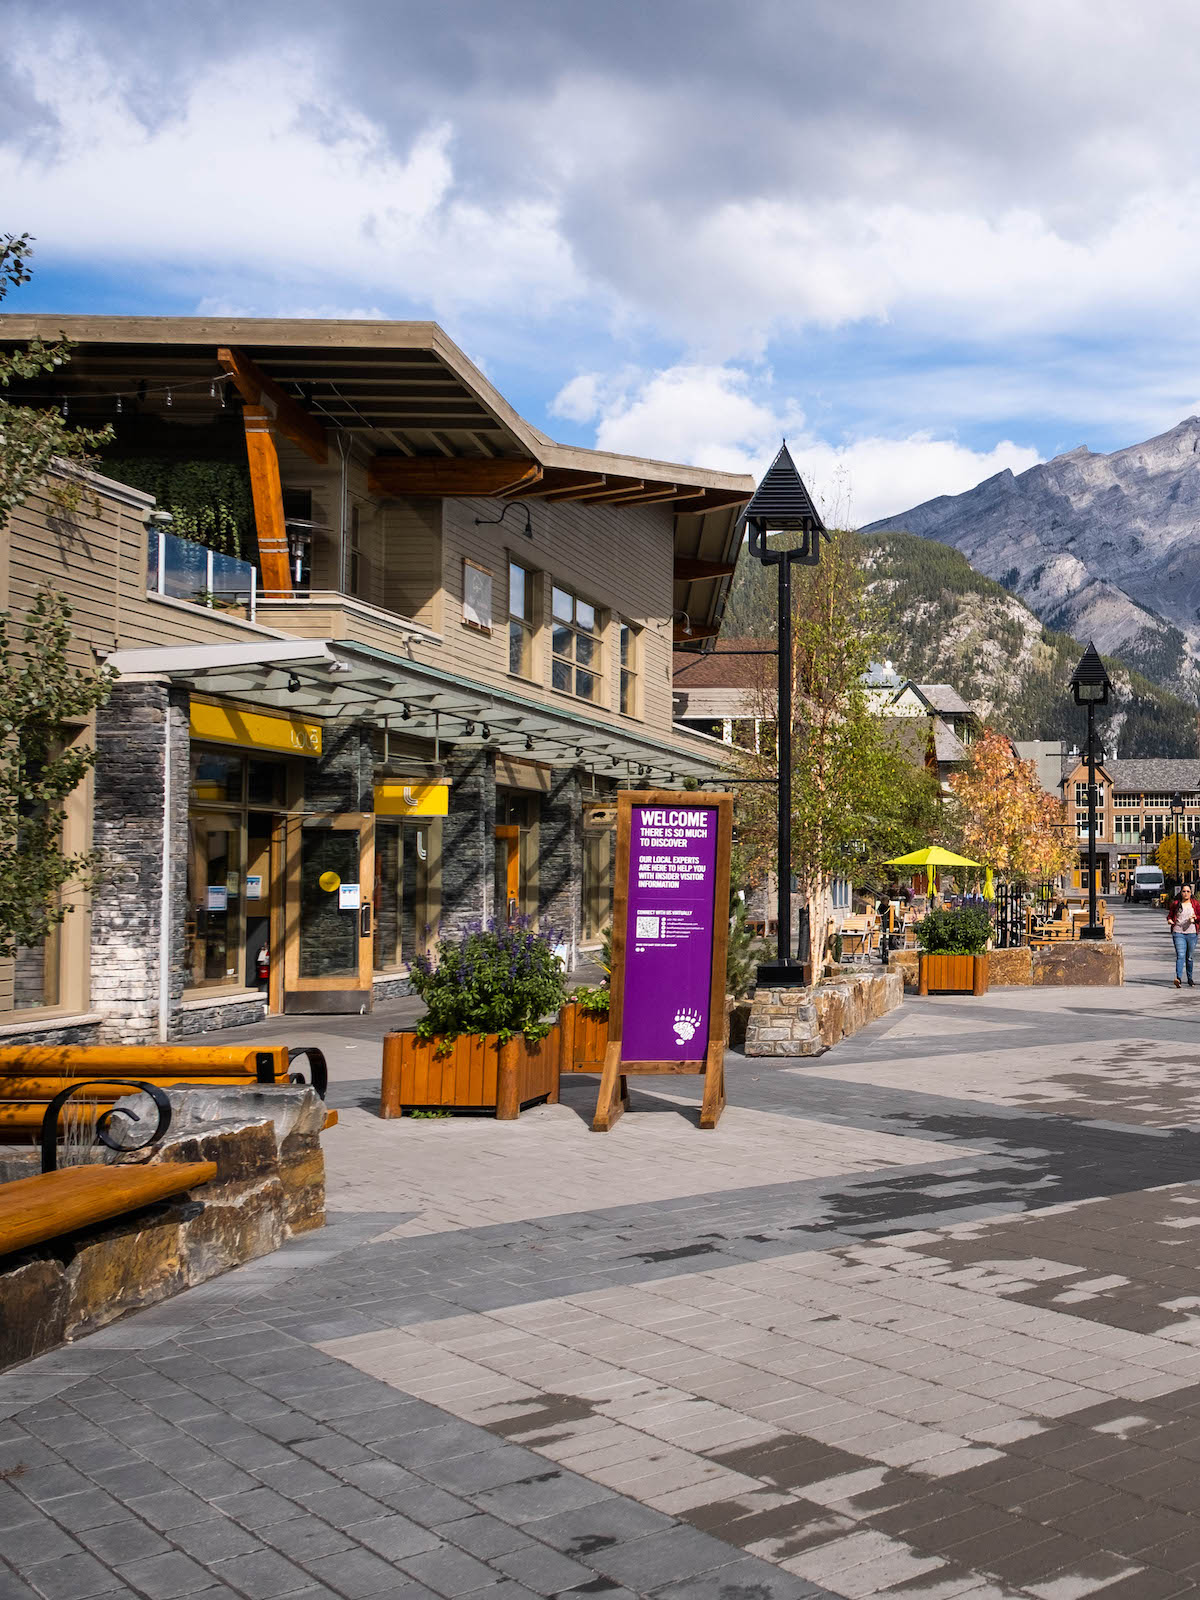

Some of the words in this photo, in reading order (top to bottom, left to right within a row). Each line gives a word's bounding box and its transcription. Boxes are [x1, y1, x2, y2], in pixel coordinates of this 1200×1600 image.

[641, 810, 708, 827] WELCOME
[640, 828, 664, 837] THERE
[665, 828, 673, 837] IS
[673, 828, 684, 838] SO
[685, 829, 708, 838] MUCH
[640, 838, 650, 847] TO
[651, 838, 688, 848] DISCOVER
[639, 855, 652, 863] OUR
[672, 856, 700, 864] EXPERTS
[651, 864, 668, 872] HERE
[668, 864, 676, 872] TO
[676, 864, 693, 872] HELP
[693, 865, 707, 873] YOU
[638, 872, 655, 880] WITH
[655, 872, 680, 880] INSIDER
[680, 873, 704, 881] VISITOR
[638, 880, 680, 889] INFORMATION
